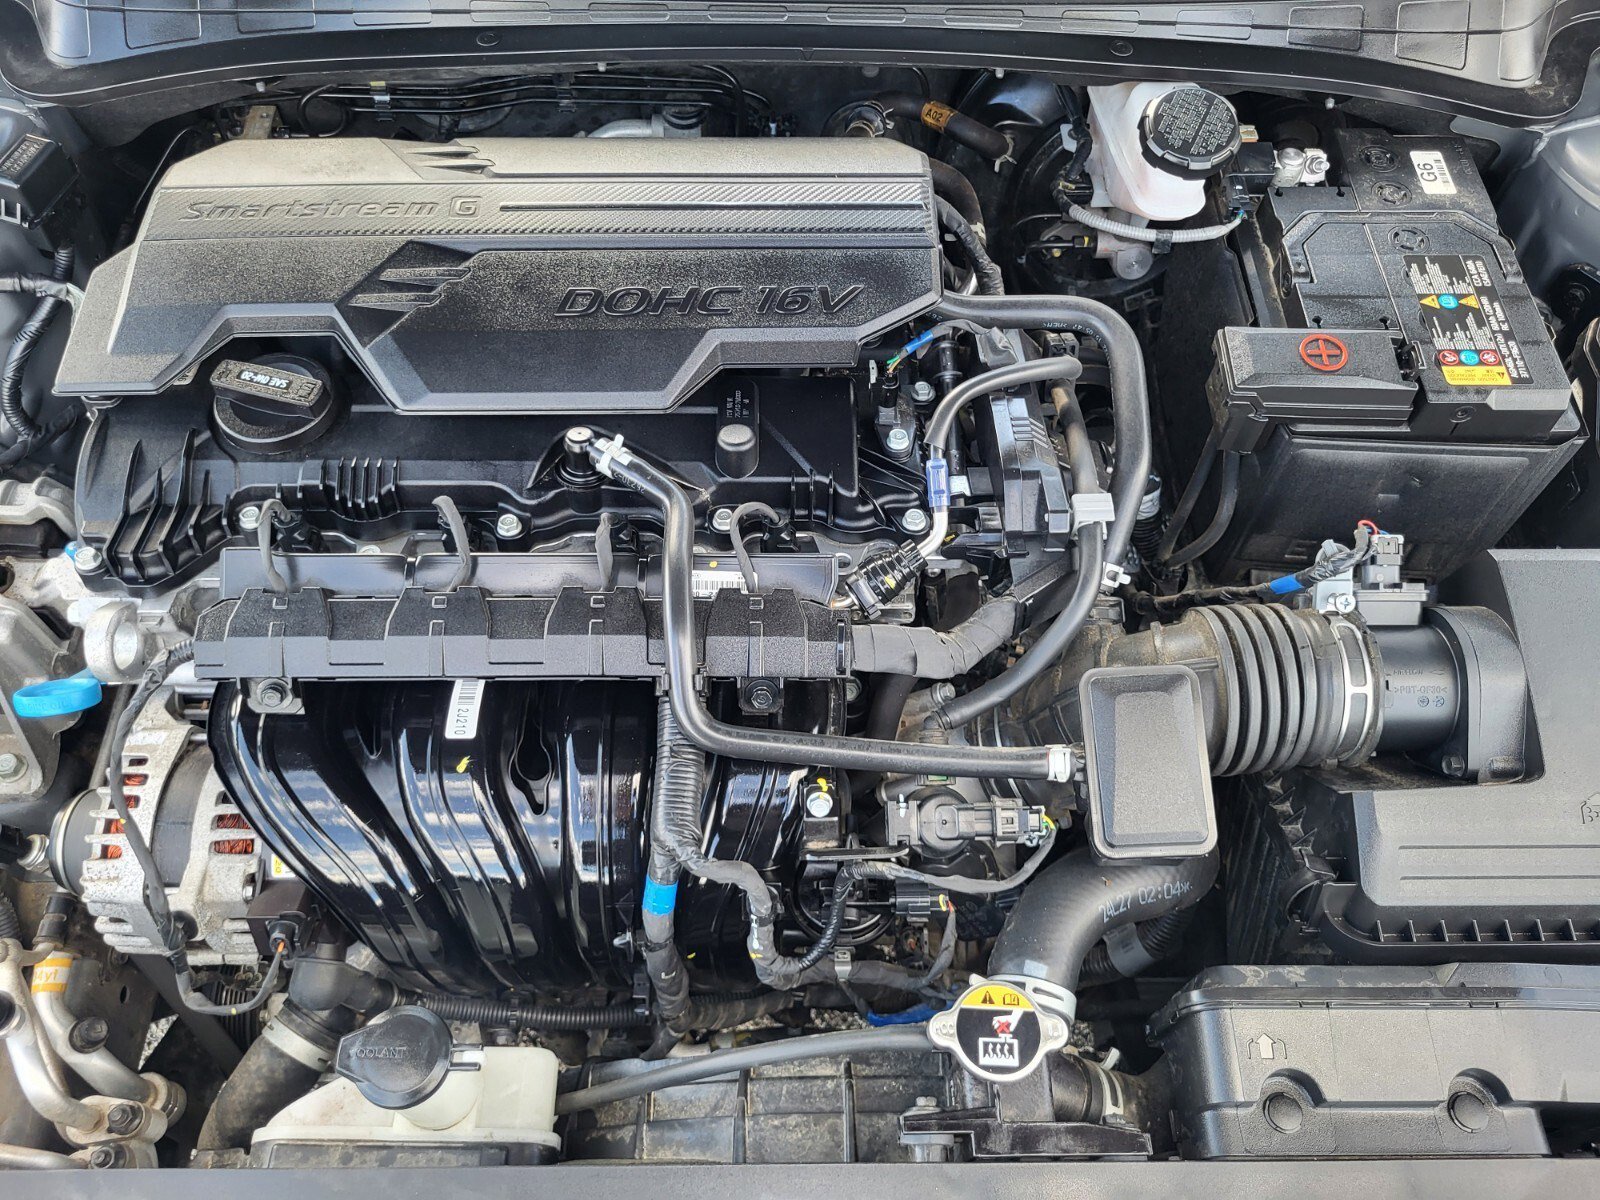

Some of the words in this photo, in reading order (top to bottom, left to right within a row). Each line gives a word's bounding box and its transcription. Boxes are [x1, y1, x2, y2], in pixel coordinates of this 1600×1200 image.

[926, 108, 943, 122] A02
[1416, 163, 1438, 182] G6
[178, 198, 439, 220] Smartstream
[453, 198, 479, 217] G
[554, 286, 743, 317] DOHC
[755, 285, 865, 315] 16V
[240, 371, 271, 384] 0W-20
[268, 378, 290, 388] SAE
[454, 708, 470, 736] 2J210
[1098, 890, 1132, 924] 24L27
